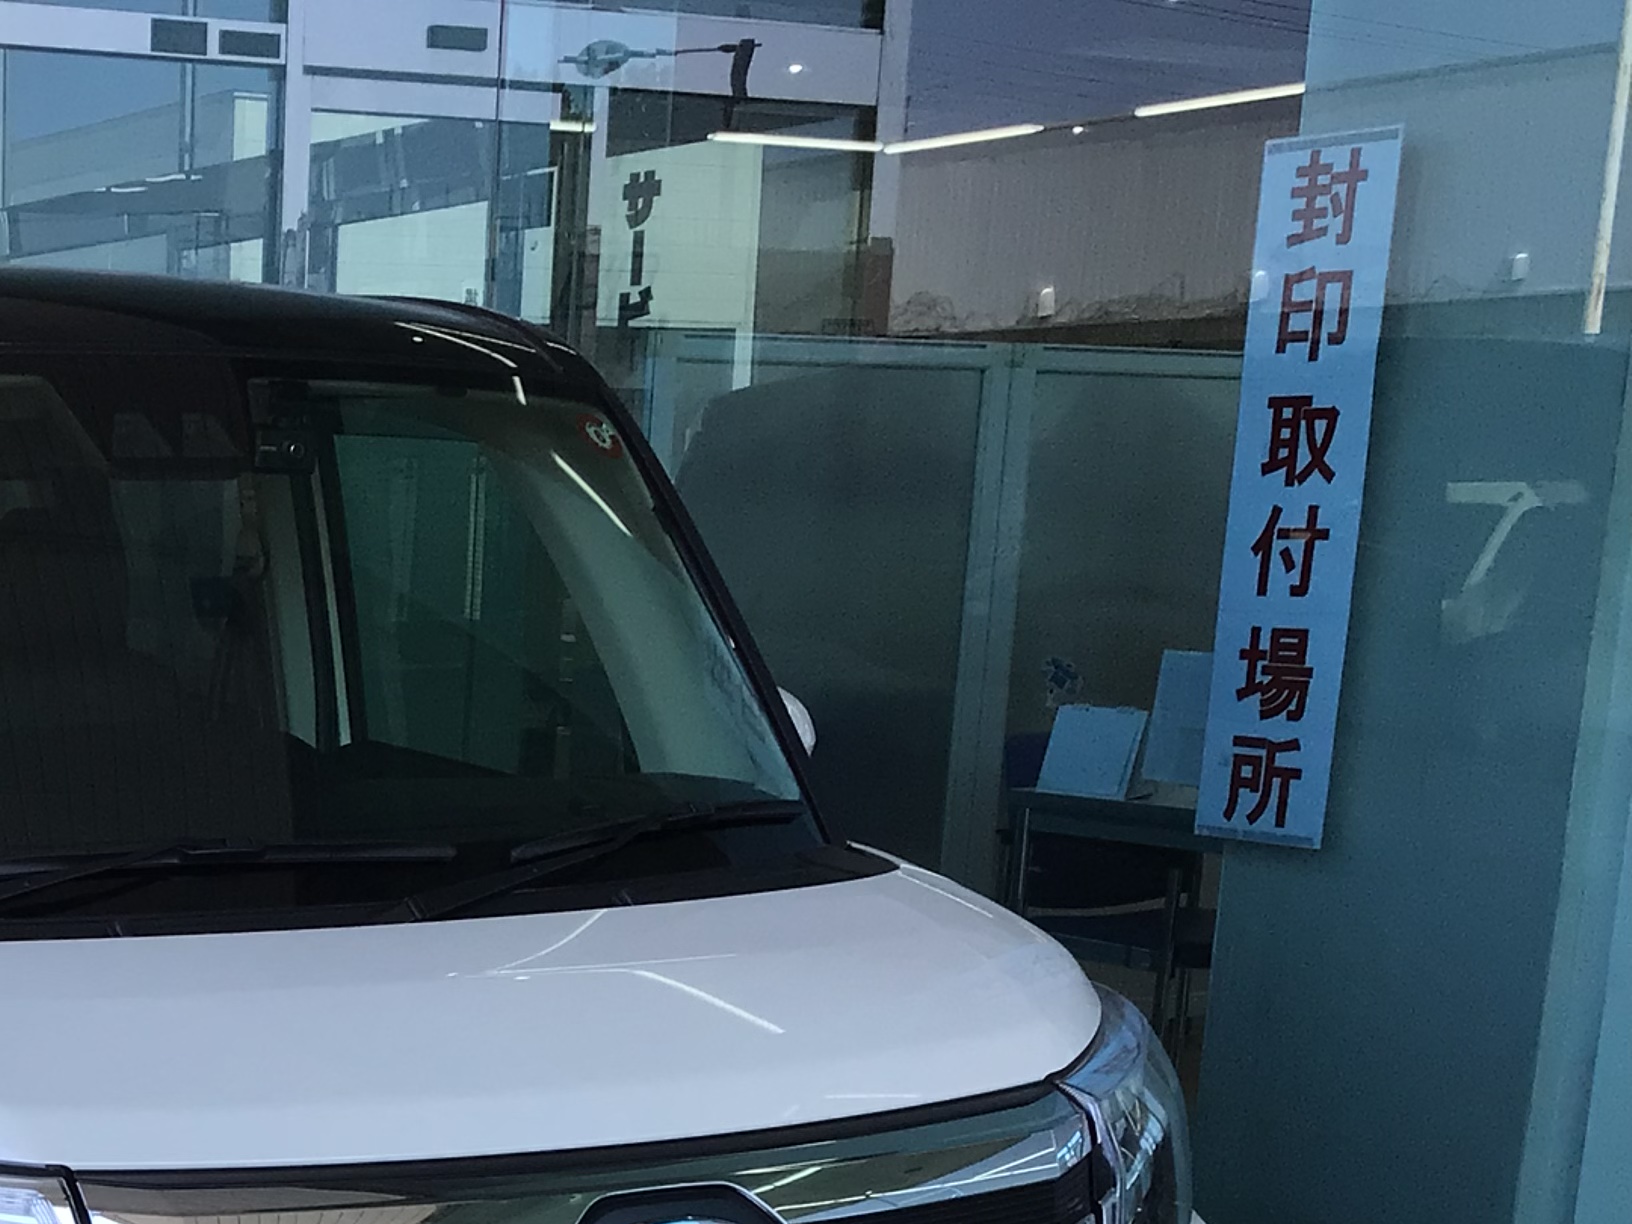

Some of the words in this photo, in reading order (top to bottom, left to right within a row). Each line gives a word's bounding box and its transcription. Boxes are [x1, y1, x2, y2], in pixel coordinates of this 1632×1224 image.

[1222, 146, 1369, 829] 封印取付場所
